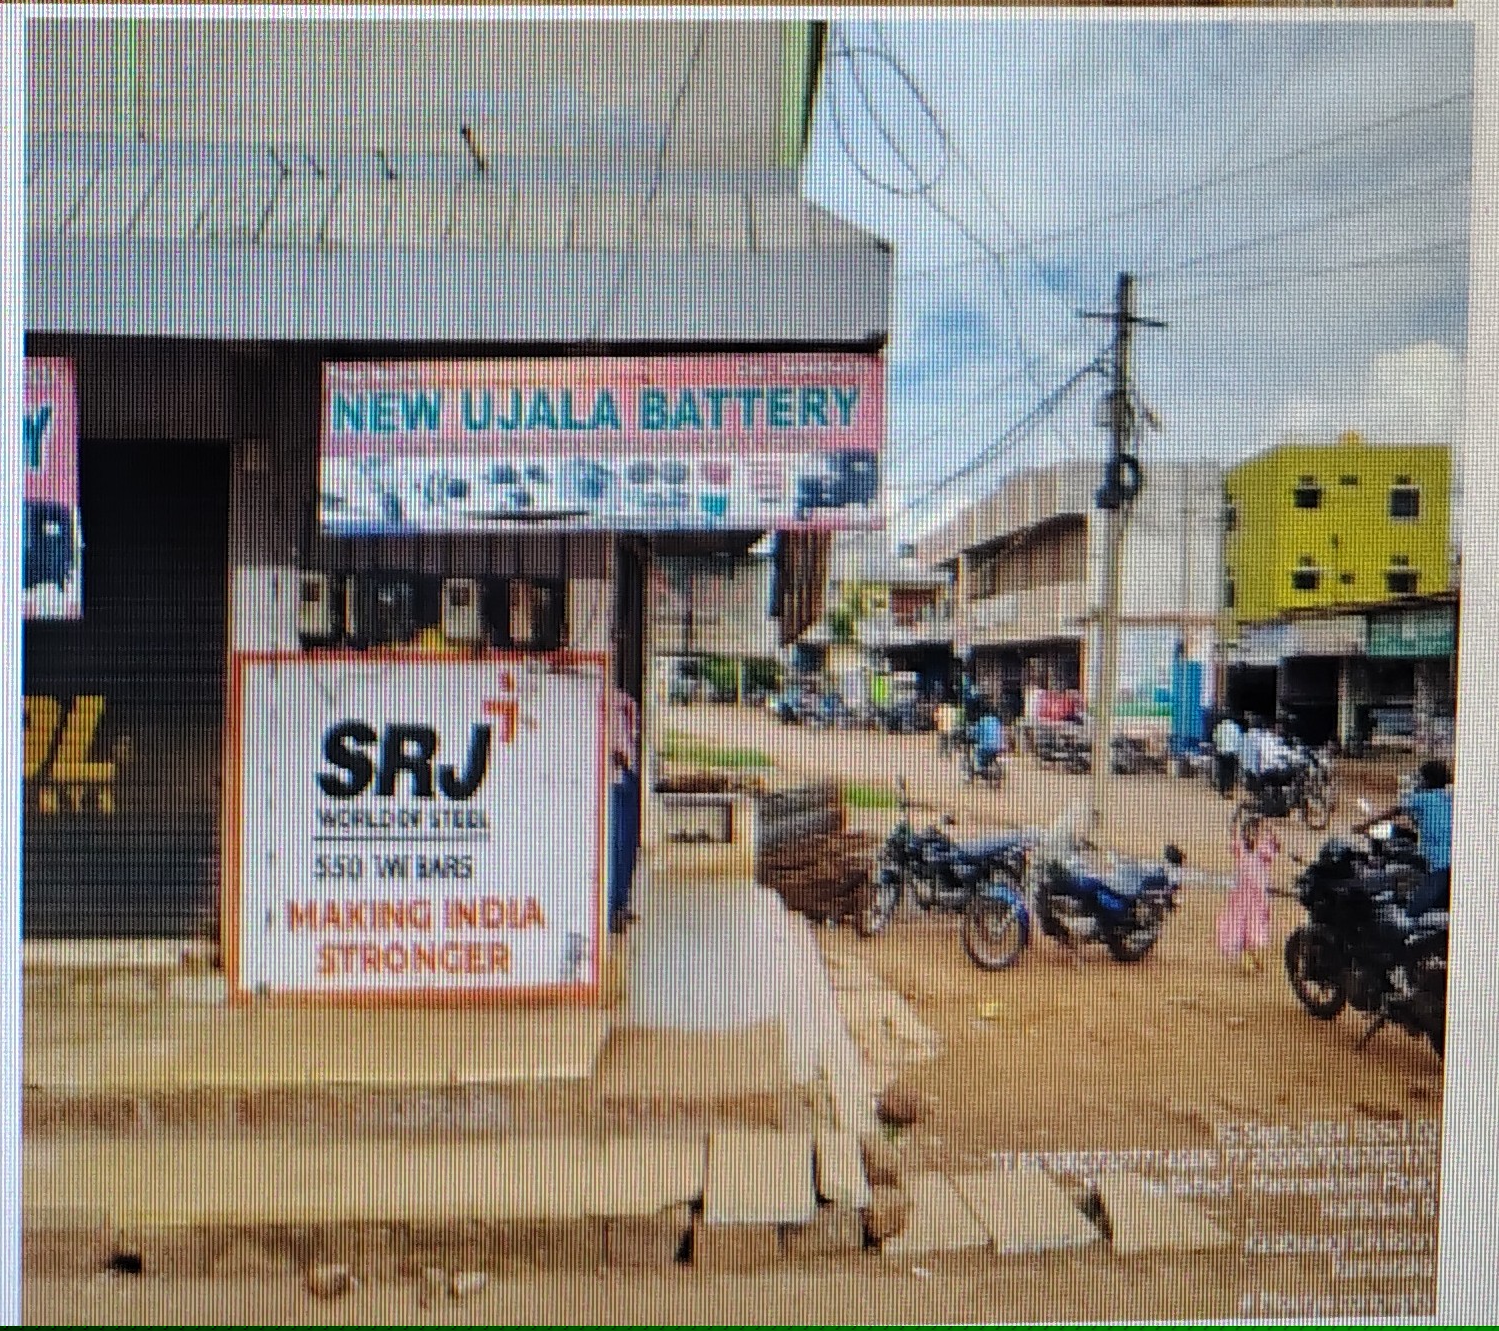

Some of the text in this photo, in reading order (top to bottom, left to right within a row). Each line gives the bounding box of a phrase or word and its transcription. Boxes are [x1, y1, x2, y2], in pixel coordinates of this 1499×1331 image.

[331, 385, 862, 434] NEW UJALA BATTERY
[315, 719, 493, 801] SRJ
[315, 808, 394, 830] WORLD
[429, 808, 490, 830] STEEL
[314, 855, 364, 881] 550
[417, 855, 474, 881] BARS
[286, 896, 547, 933] MAKING INDIA
[317, 941, 511, 978] STRONGER
